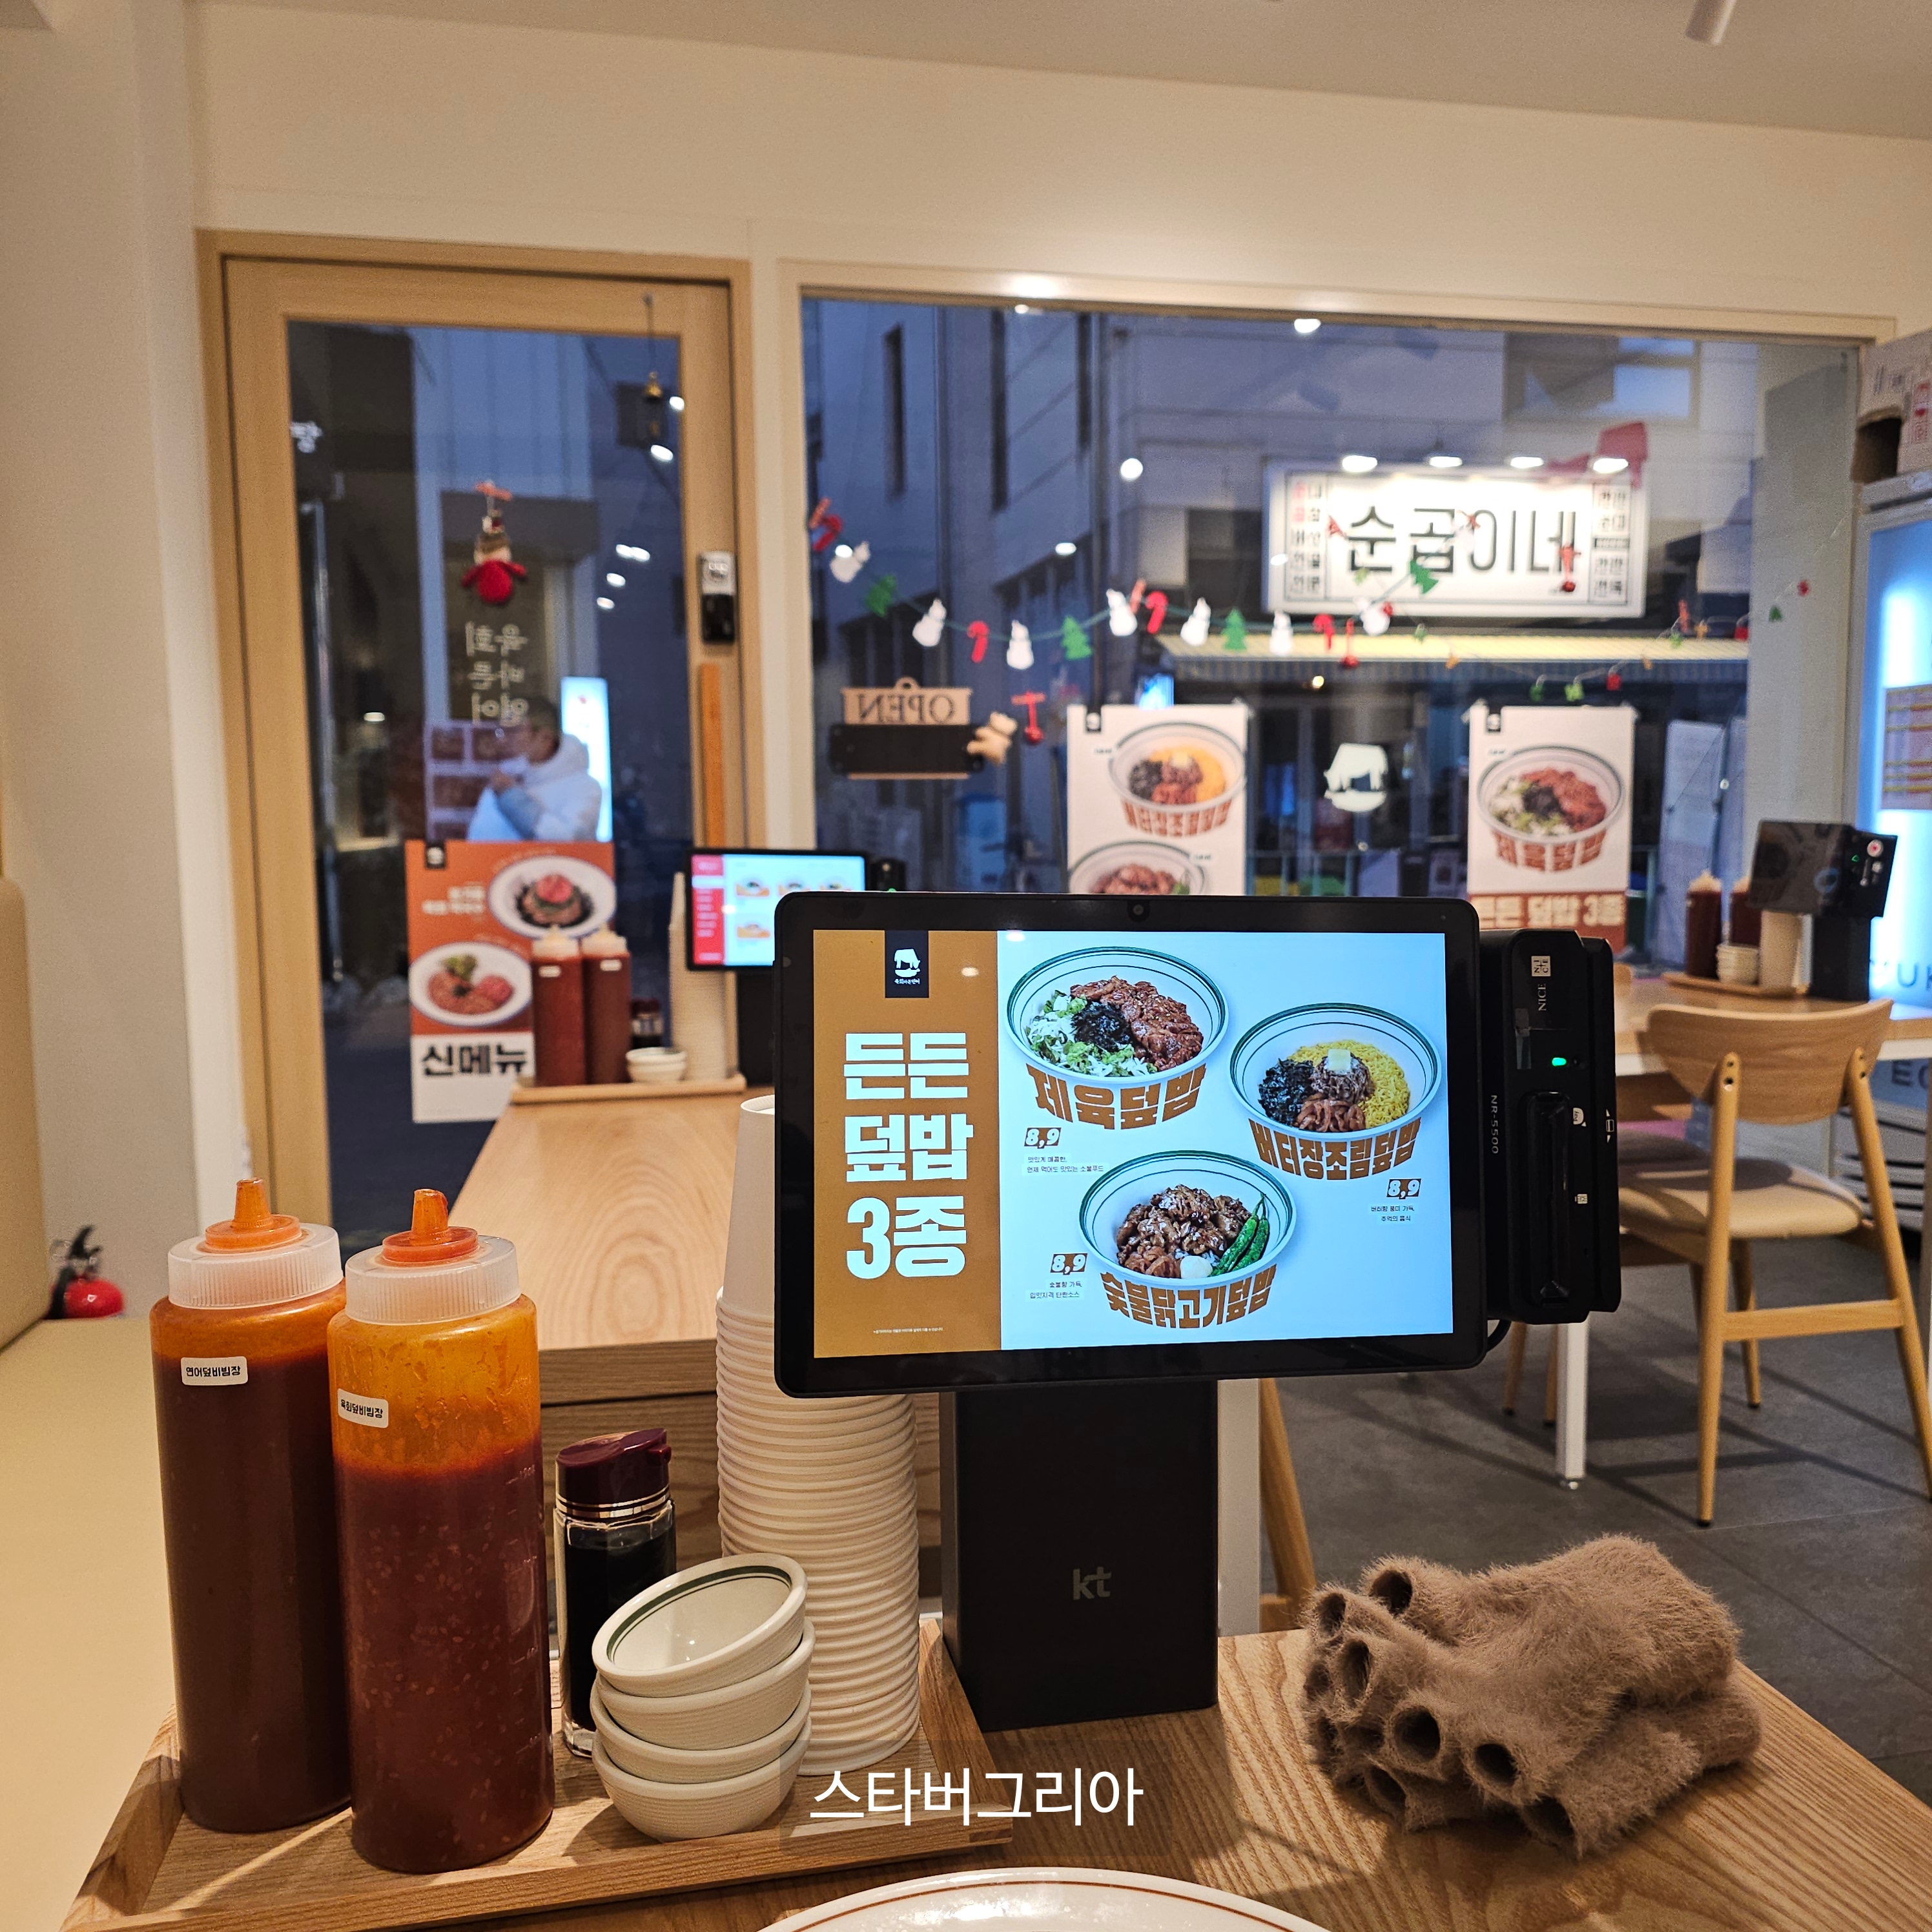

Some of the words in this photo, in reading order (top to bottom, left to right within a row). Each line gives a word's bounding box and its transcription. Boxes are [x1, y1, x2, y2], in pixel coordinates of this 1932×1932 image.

[1348, 506, 1576, 573] 순곱이네
[1527, 894, 1580, 928] 덮밥
[1583, 894, 1625, 927] 3종
[1537, 983, 1547, 1011] NICE
[422, 1043, 526, 1076] 신메뉴
[844, 1033, 969, 1100] 든든
[1025, 1063, 1207, 1130] 제육덮밥
[845, 1113, 974, 1182] 덮밥
[1025, 1127, 1060, 1148] 8,9
[1248, 1117, 1421, 1180] 버터장조림덮밥
[1387, 1179, 1421, 1199] 8,9
[846, 1195, 967, 1279] 3종
[1051, 1254, 1087, 1275] 8,9
[1100, 1264, 1277, 1329] 숯불닭고기덮밥
[186, 1365, 241, 1377] 연어덮비빔장
[340, 1399, 384, 1419] 육회덮비빔장
[1073, 1566, 1112, 1600] kt
